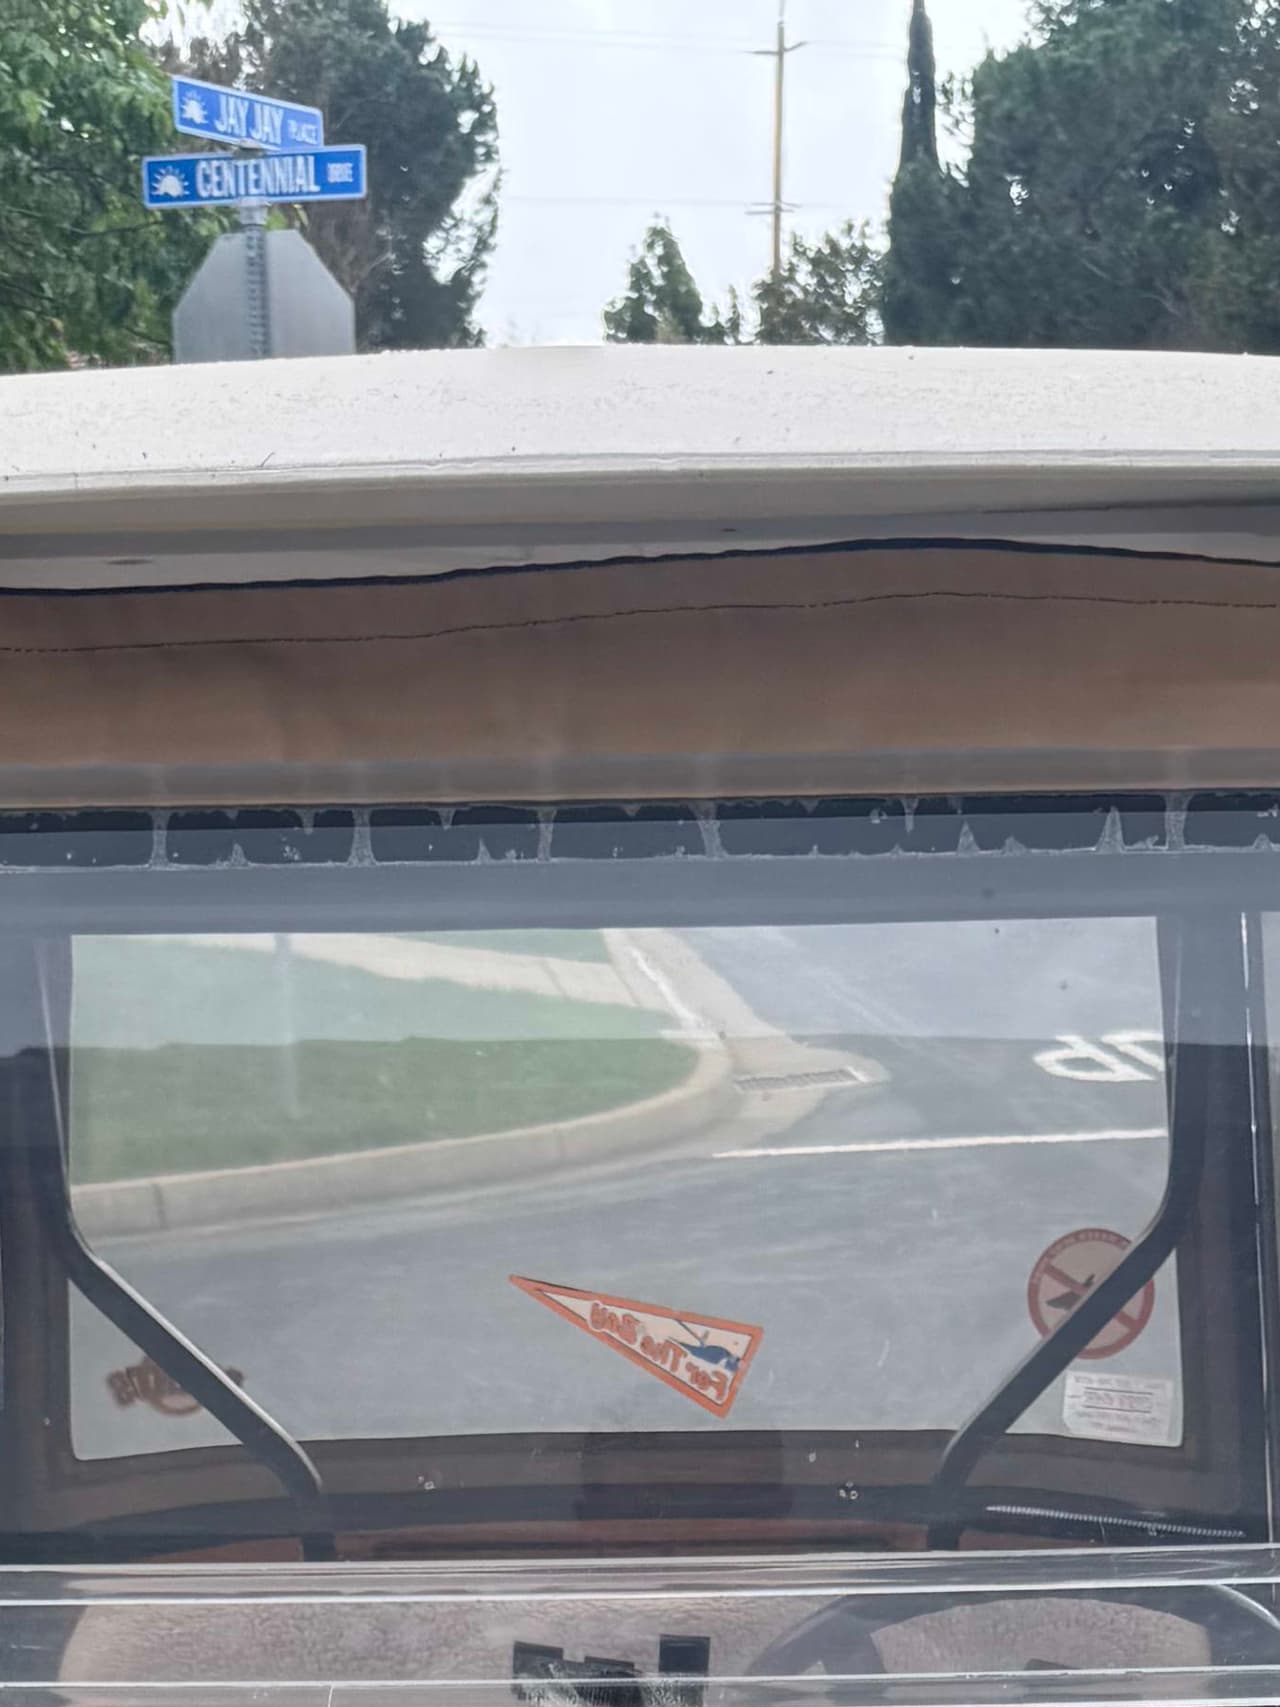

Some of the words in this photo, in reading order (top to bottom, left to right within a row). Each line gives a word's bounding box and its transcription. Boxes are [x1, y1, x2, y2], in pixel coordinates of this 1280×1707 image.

[215, 94, 249, 138] JAY
[249, 101, 285, 145] JAY
[195, 155, 321, 198] CENTENNIAL
